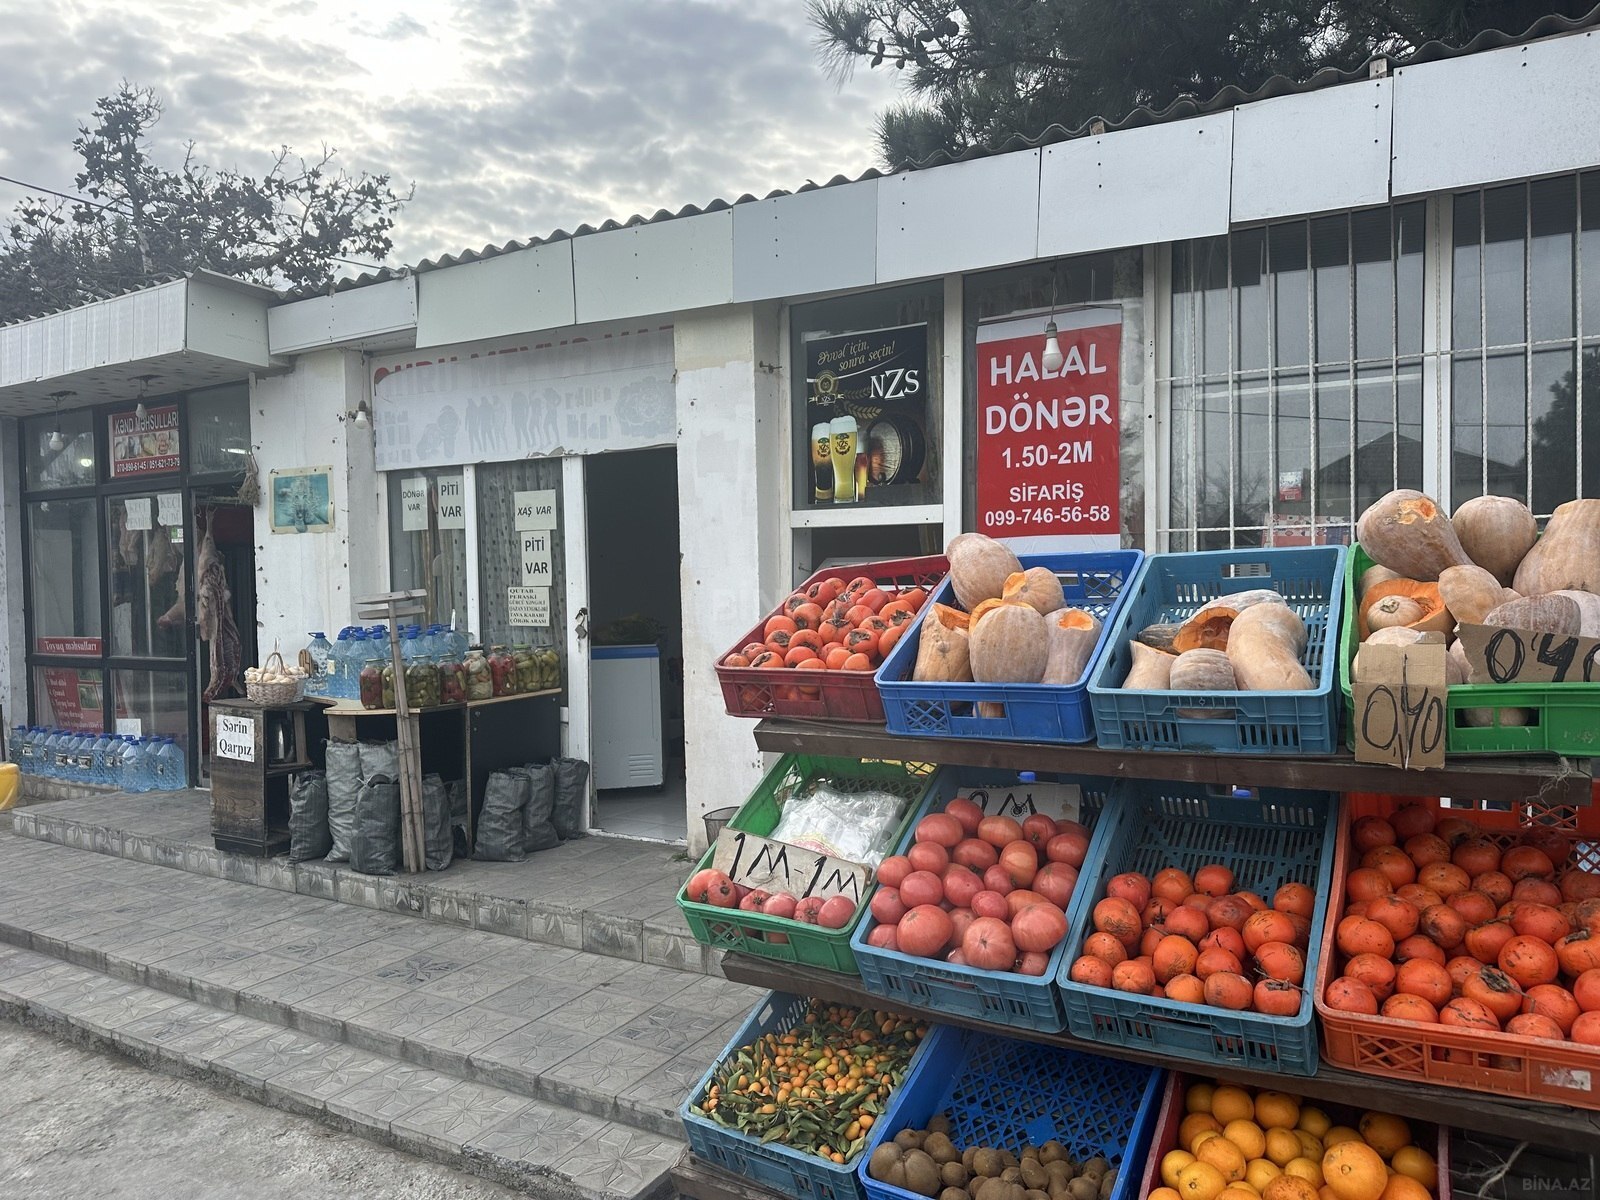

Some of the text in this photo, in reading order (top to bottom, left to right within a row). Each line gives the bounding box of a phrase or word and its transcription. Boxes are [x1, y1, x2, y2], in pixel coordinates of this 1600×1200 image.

[838, 340, 896, 371] sonra seçin!
[990, 343, 1107, 386] HALAL
[870, 368, 920, 400] NZS
[985, 392, 1113, 435] DÖNƏR
[115, 417, 134, 434] KƏND
[1002, 440, 1093, 469] 1.50-2M
[441, 481, 459, 496] PİTİ
[1009, 479, 1084, 503] SİFARİŞ
[407, 503, 421, 511] VAR
[441, 505, 462, 518] VAR
[517, 505, 552, 518] XAŞ VAR
[985, 505, 1111, 527] 099-746-56-58
[525, 536, 545, 552] PİTİ
[525, 562, 549, 574] VAR
[44, 640, 65, 653] Toyuq
[222, 718, 248, 734] Sərin
[219, 738, 252, 758] Qarpız
